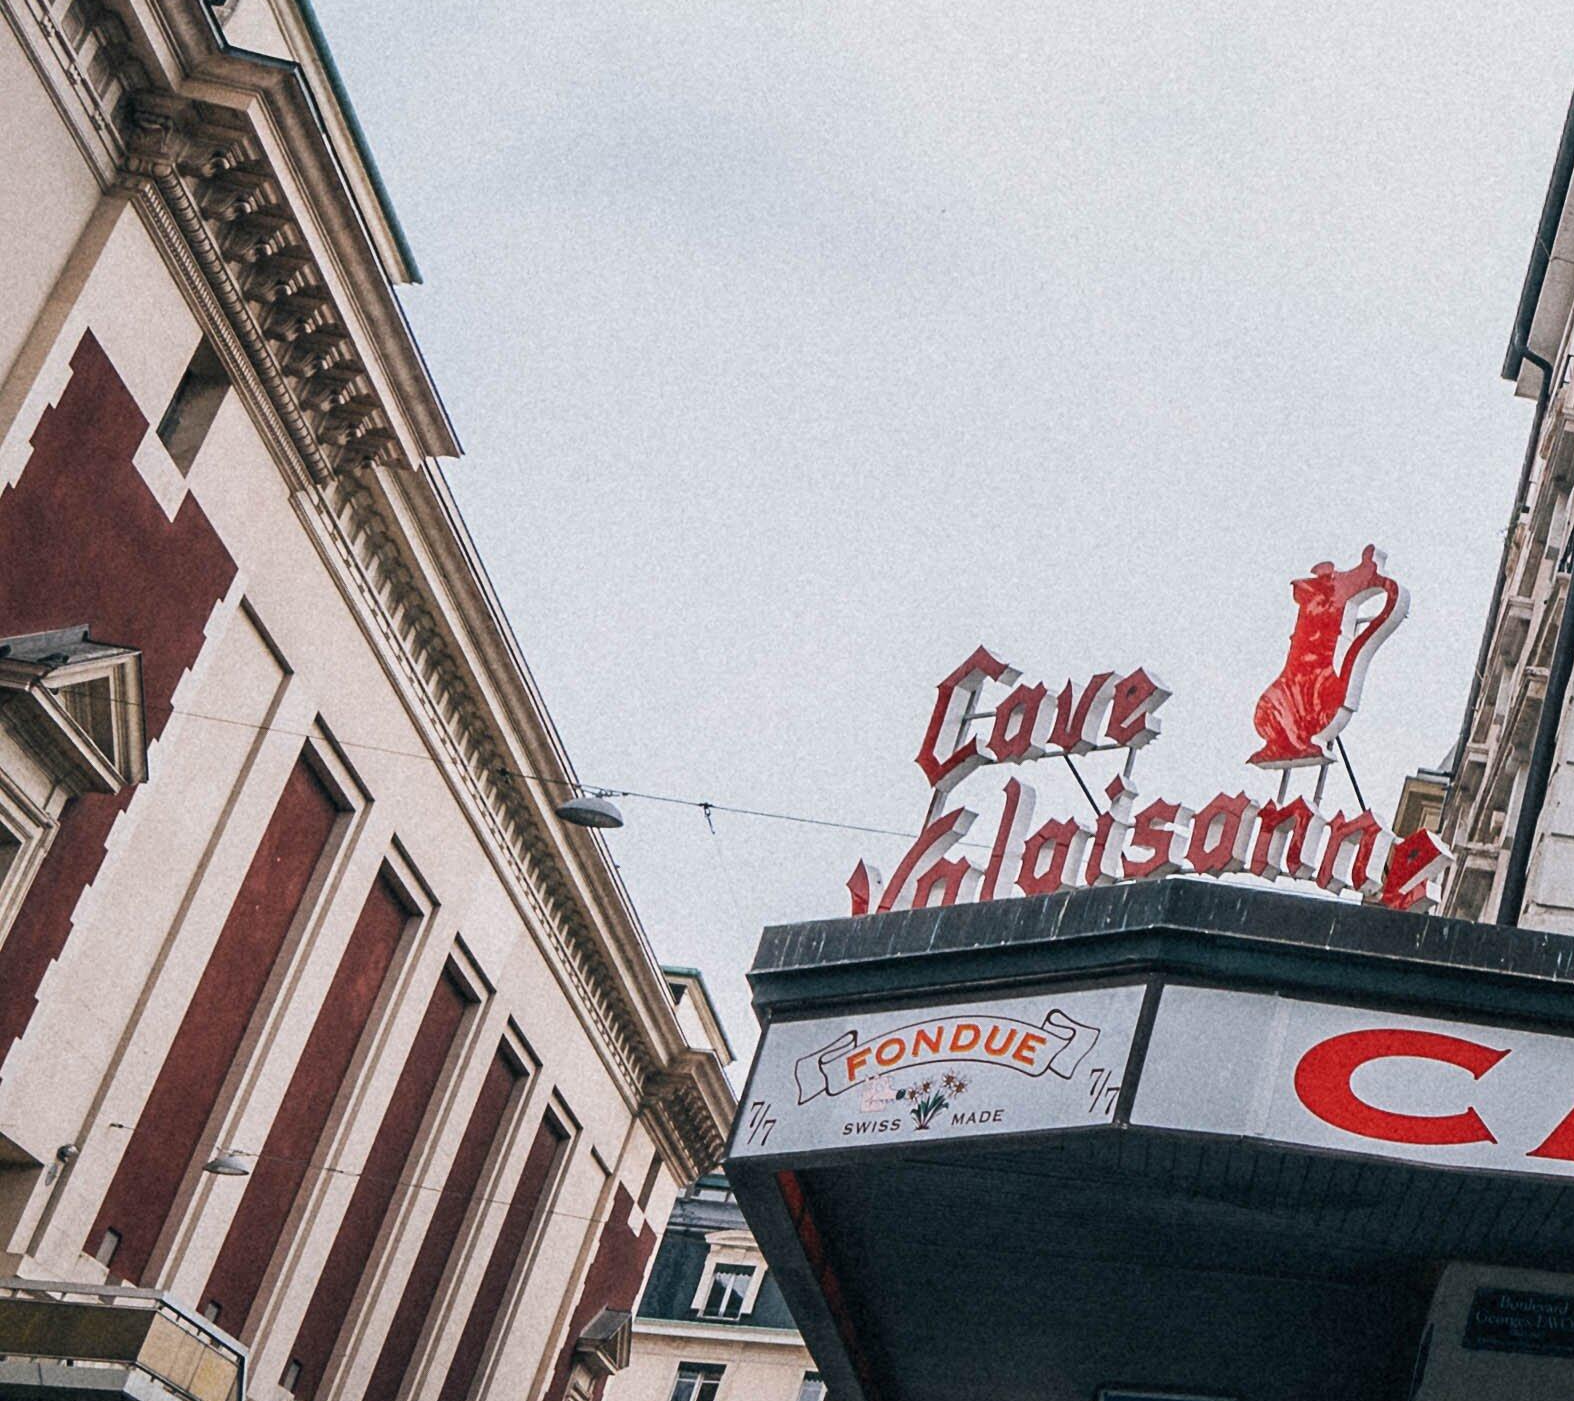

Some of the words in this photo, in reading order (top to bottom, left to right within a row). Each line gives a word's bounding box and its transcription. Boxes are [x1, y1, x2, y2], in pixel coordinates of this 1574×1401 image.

[916, 644, 1170, 790] Cave
[847, 776, 1452, 916] Valaisanne
[845, 1023, 1046, 1082] FONDUE
[747, 1100, 777, 1147] 7/7
[842, 1117, 902, 1137] SWISS
[951, 1108, 1006, 1128] MADE
